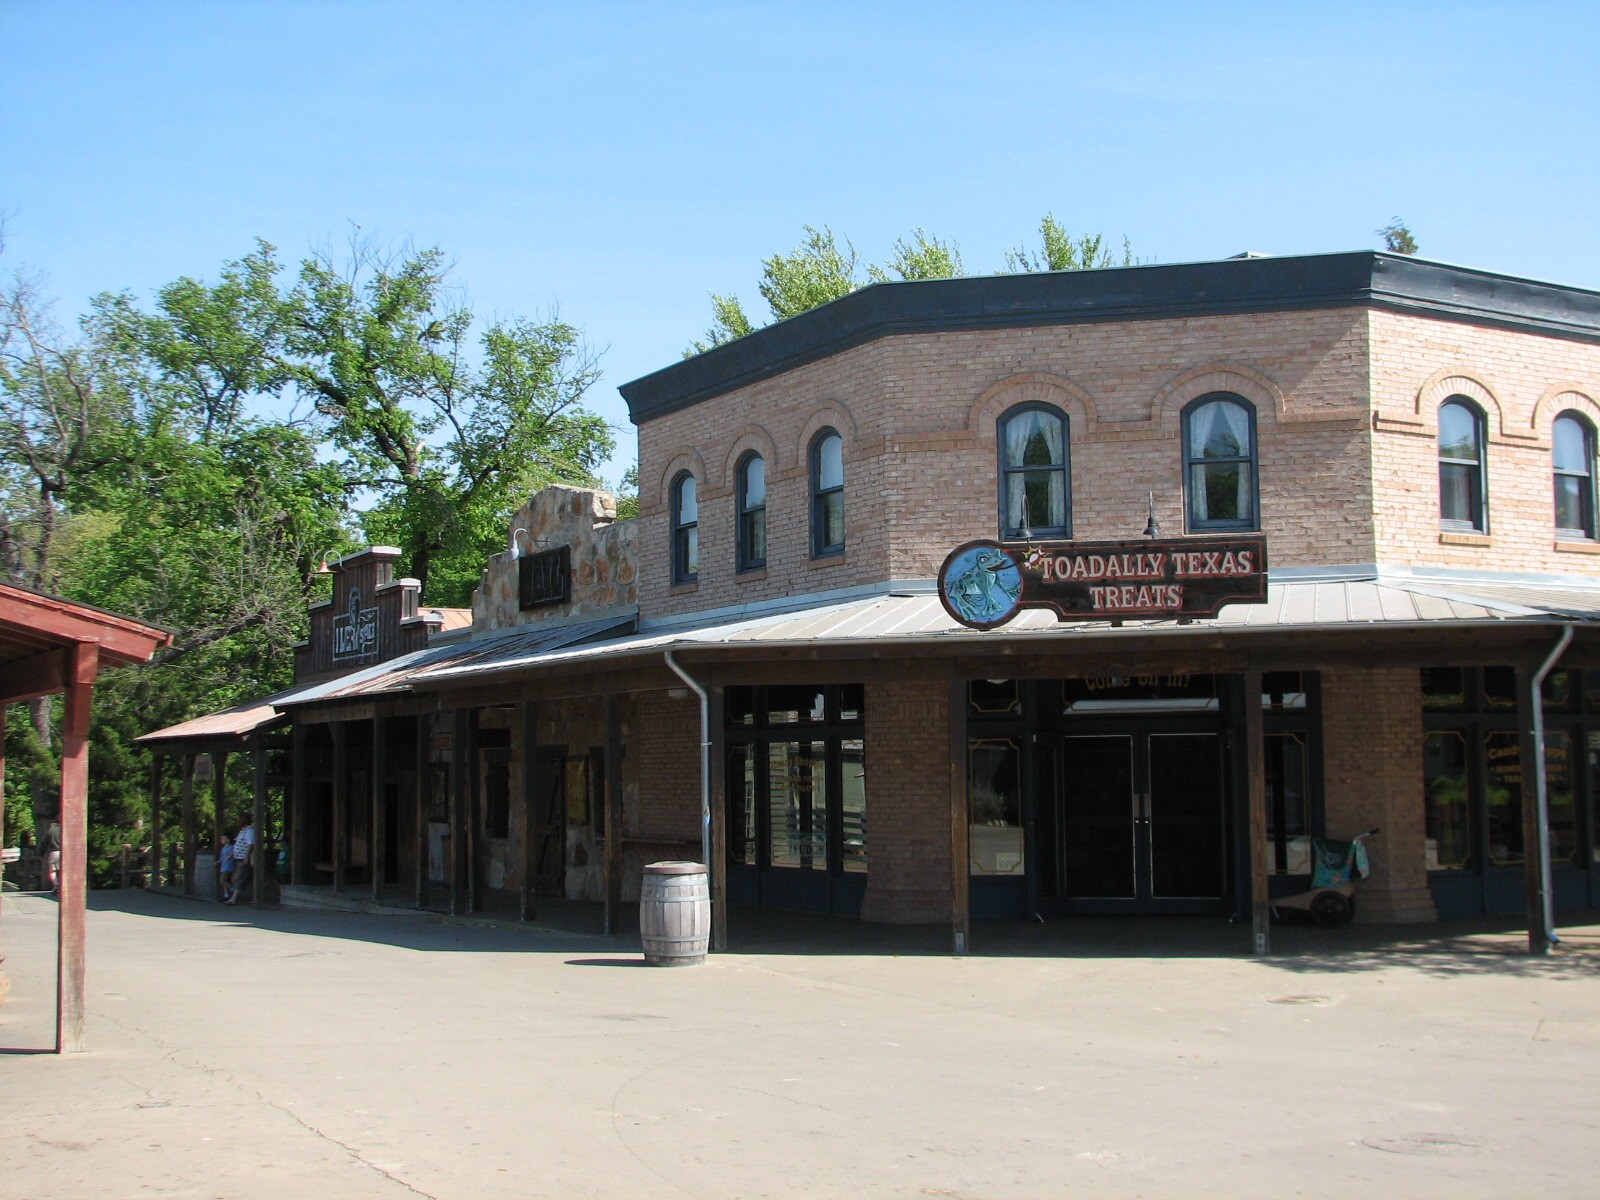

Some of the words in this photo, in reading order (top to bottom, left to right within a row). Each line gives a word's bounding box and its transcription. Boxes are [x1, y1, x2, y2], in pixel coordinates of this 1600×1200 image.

[1041, 552, 1166, 581] TOADALLY
[1172, 549, 1254, 577] TEXAS
[1089, 585, 1184, 611] TREATS
